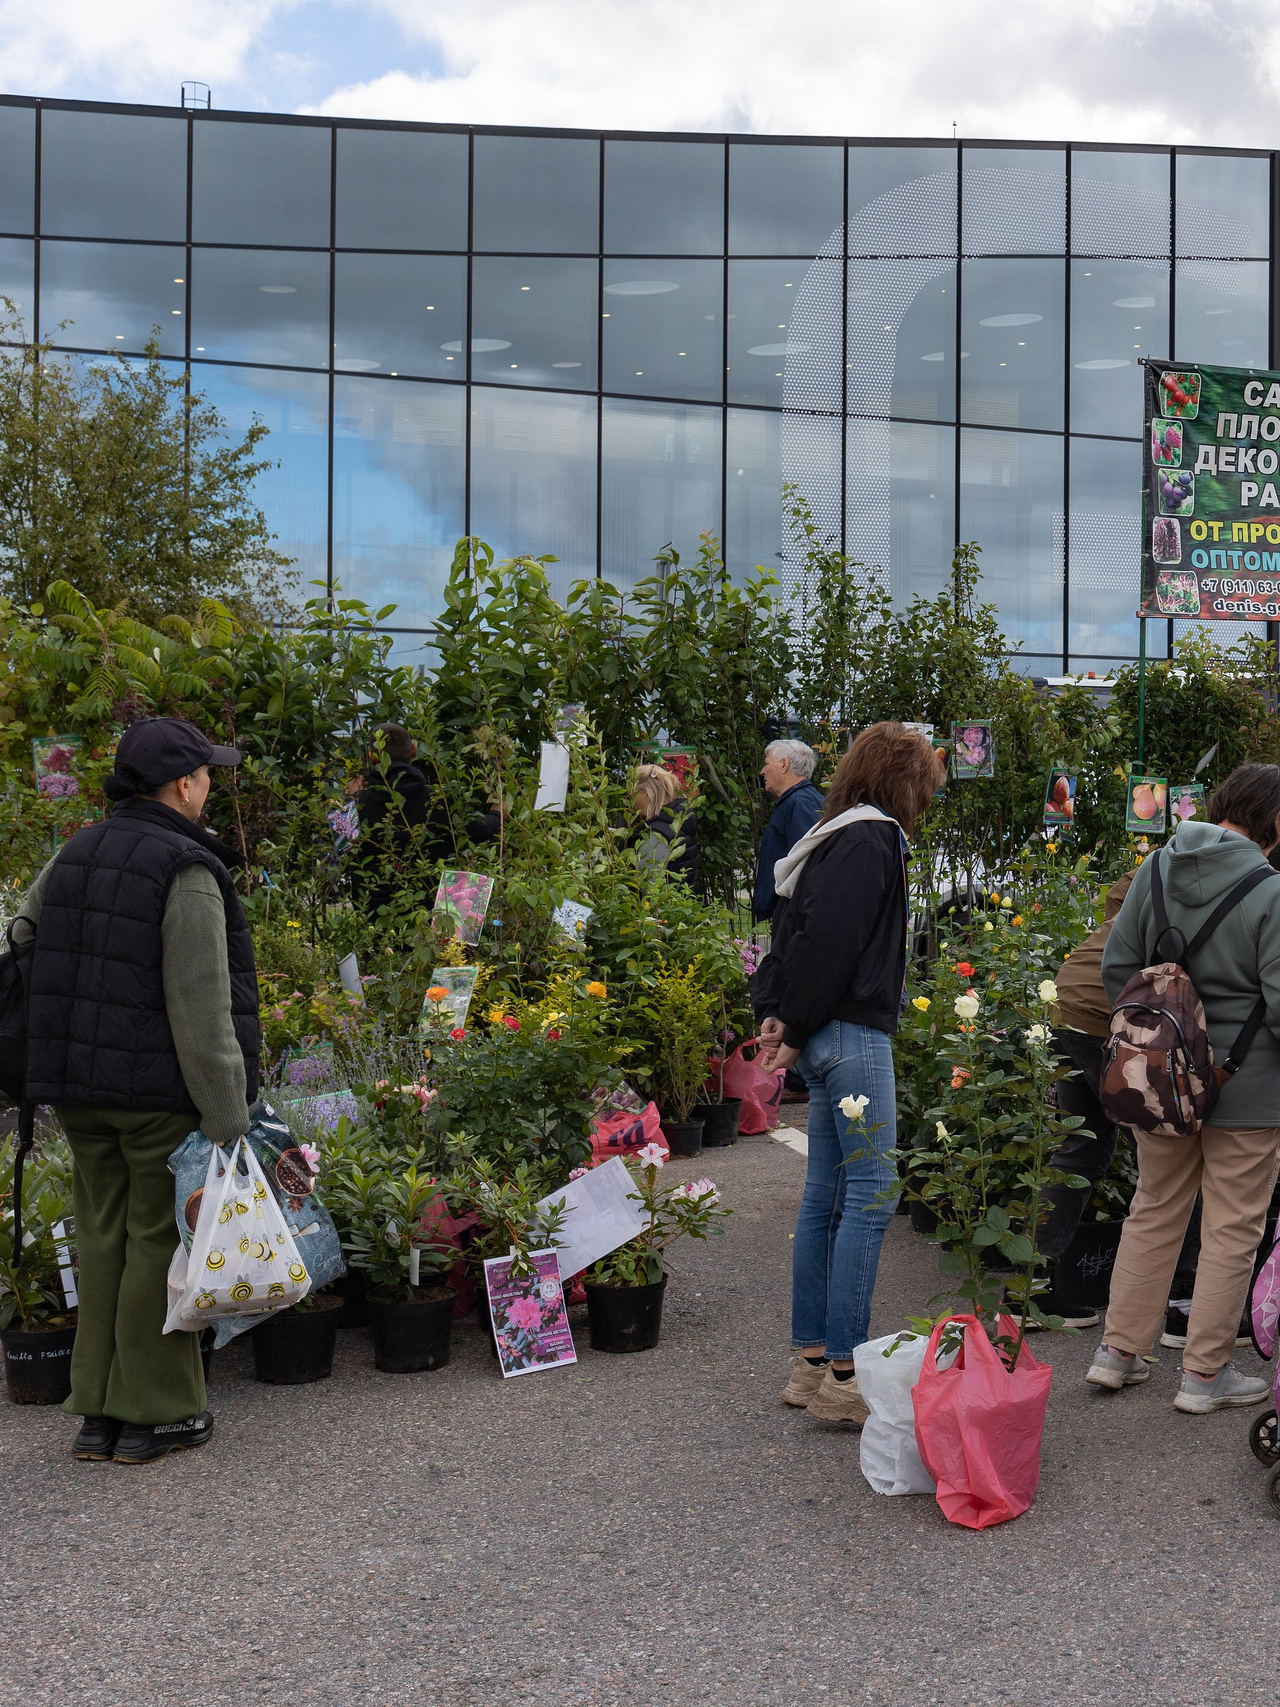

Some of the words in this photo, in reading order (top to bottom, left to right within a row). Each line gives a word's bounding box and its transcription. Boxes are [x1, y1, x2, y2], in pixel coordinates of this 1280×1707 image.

[1189, 519, 1224, 542] ОТ
[1201, 580, 1218, 593] +7
[1220, 580, 1255, 597] (911)
